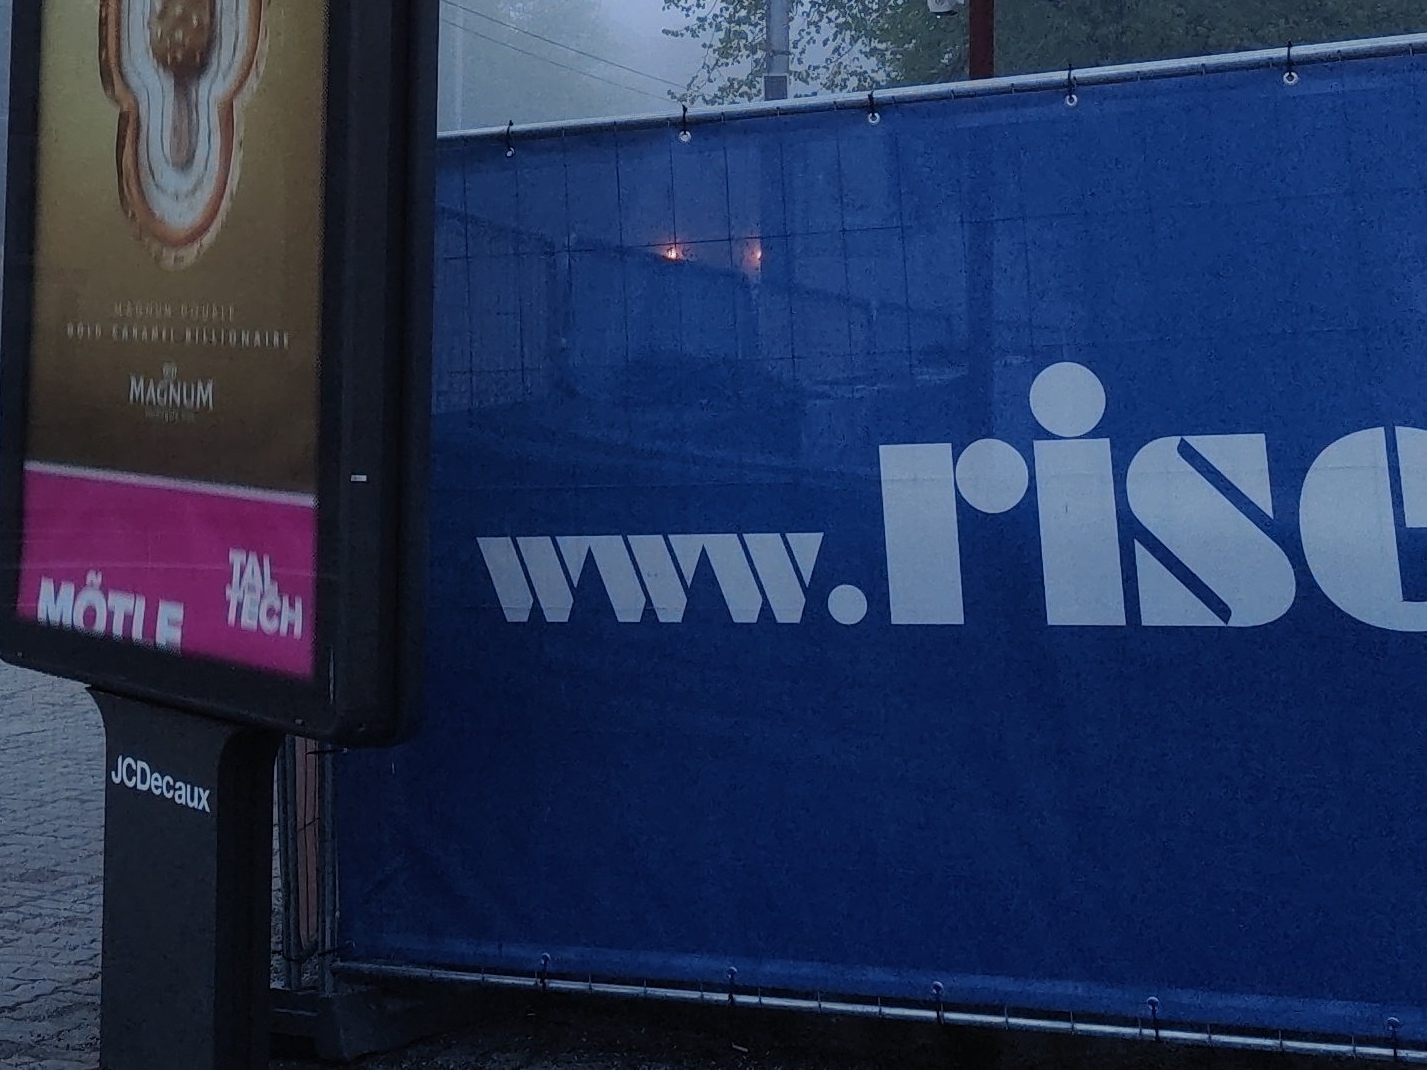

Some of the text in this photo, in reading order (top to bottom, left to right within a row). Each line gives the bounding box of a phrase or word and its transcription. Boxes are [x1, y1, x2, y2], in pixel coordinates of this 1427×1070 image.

[128, 372, 214, 411] MAGNUM
[228, 546, 279, 596] TAL
[225, 583, 303, 640] TECH
[111, 754, 211, 813] JCDecaux
